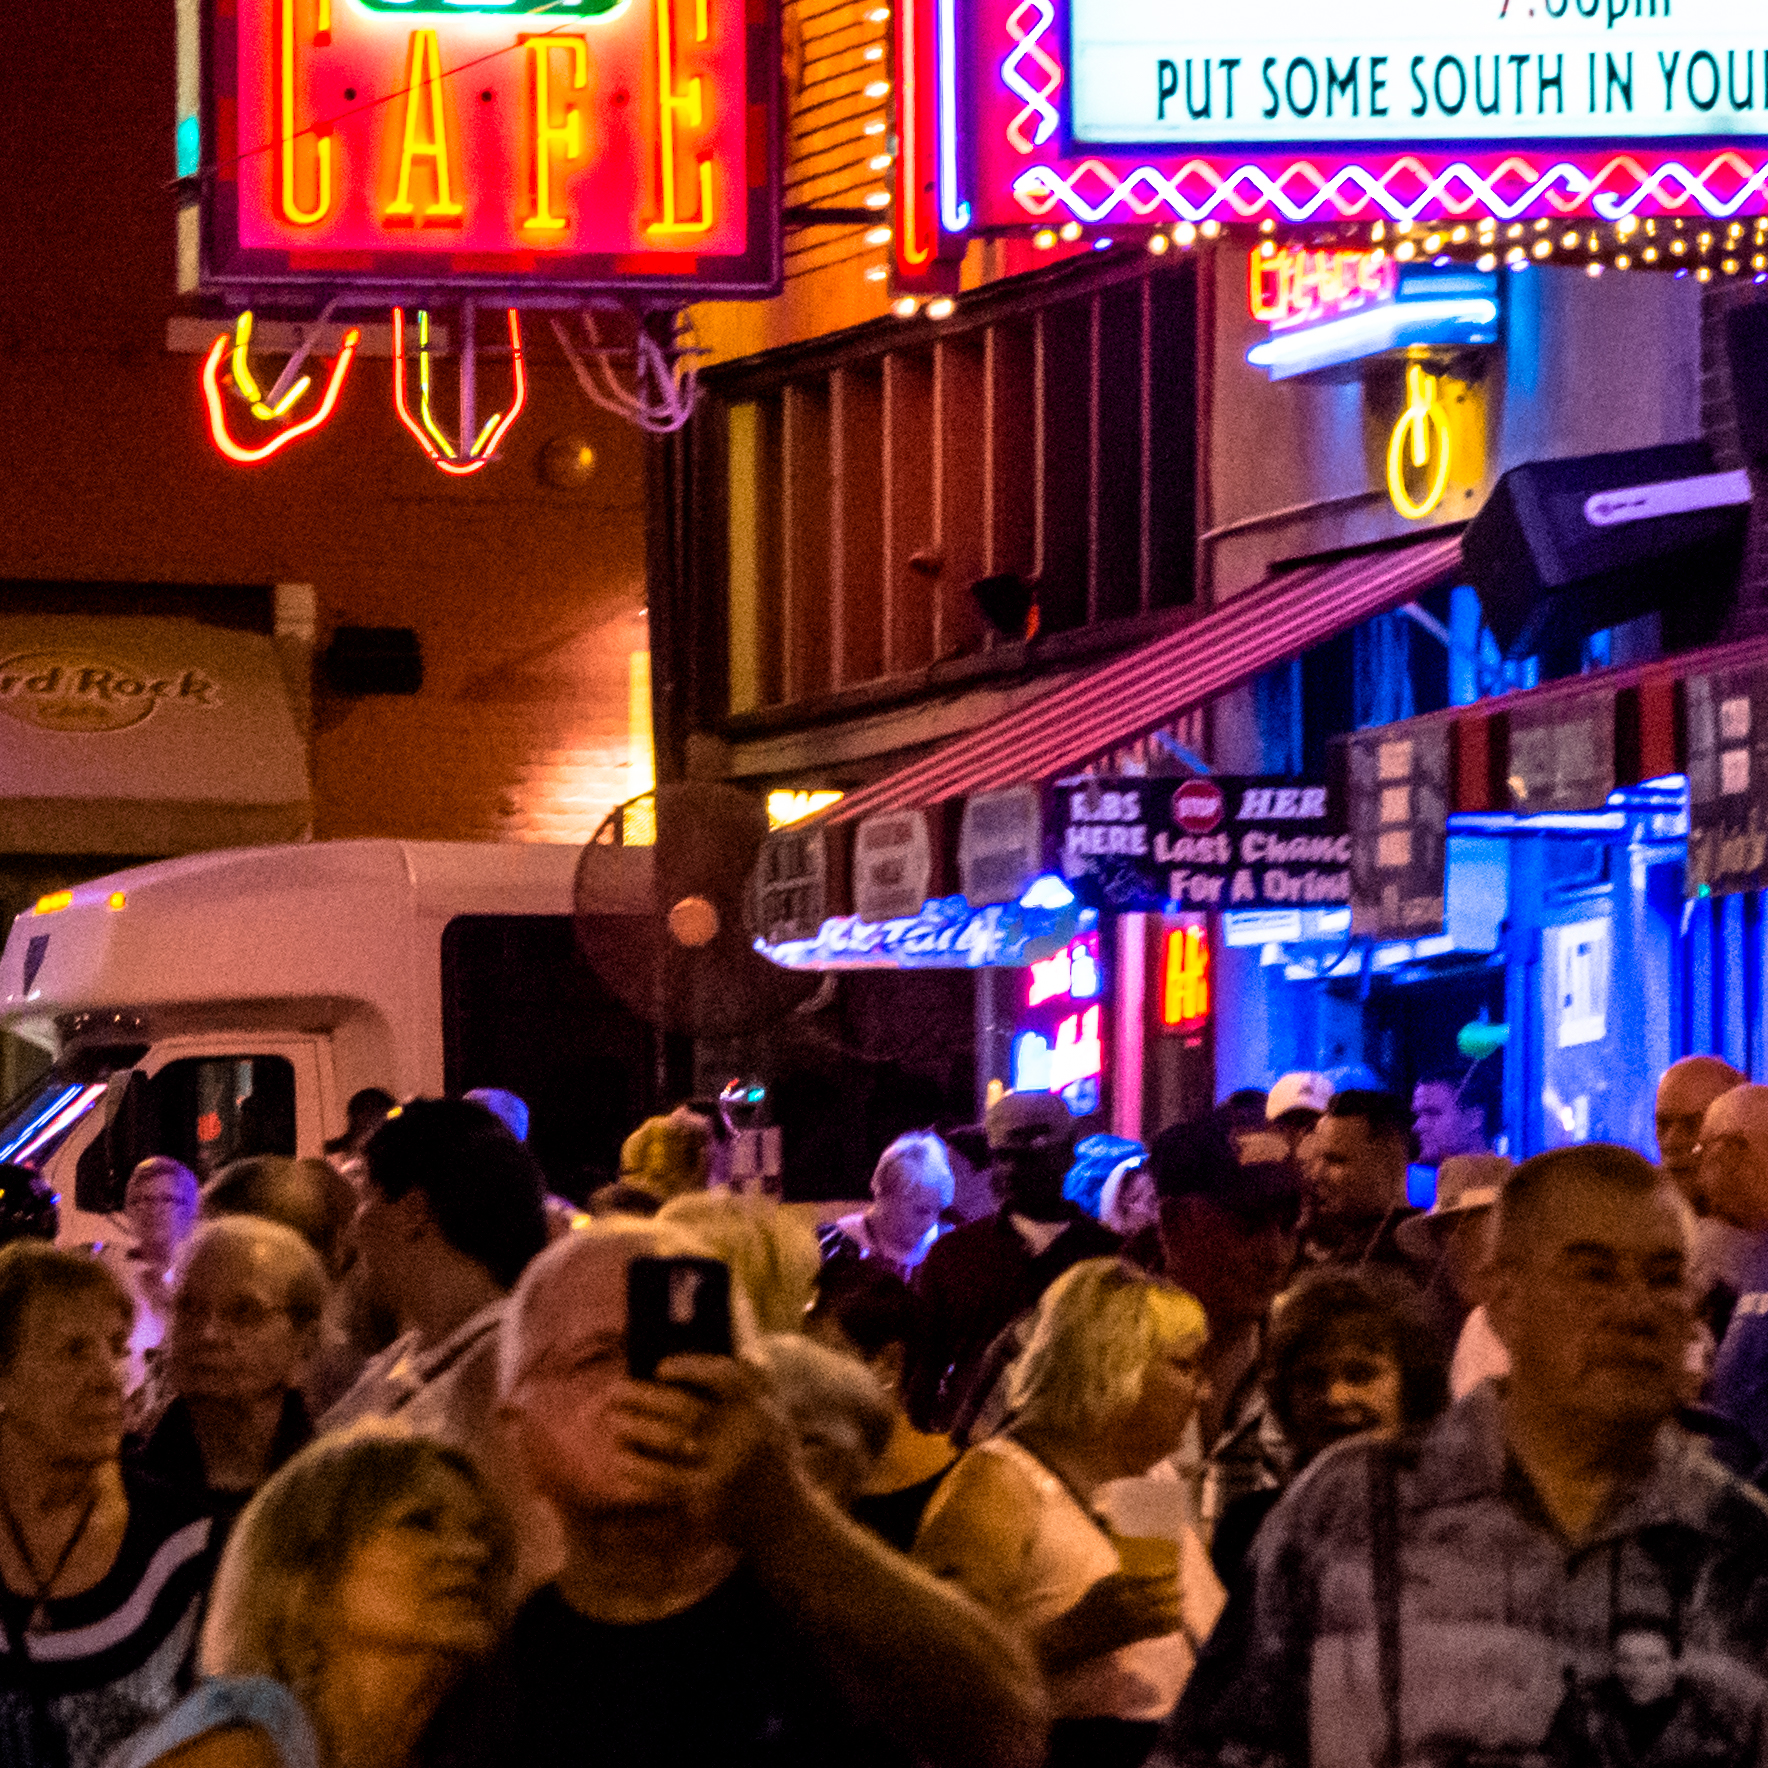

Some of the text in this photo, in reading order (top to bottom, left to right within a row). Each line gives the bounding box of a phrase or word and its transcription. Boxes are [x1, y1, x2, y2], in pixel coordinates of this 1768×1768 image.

[1157, 57, 1242, 121] PUT
[1261, 55, 1389, 119] SOME
[1410, 52, 1564, 118] SOUTH
[1588, 51, 1634, 114] IN
[74, 665, 224, 709] Rock
[1154, 832, 1351, 865] Last Chanc
[1169, 869, 1225, 903] For
[1232, 869, 1257, 902] A
